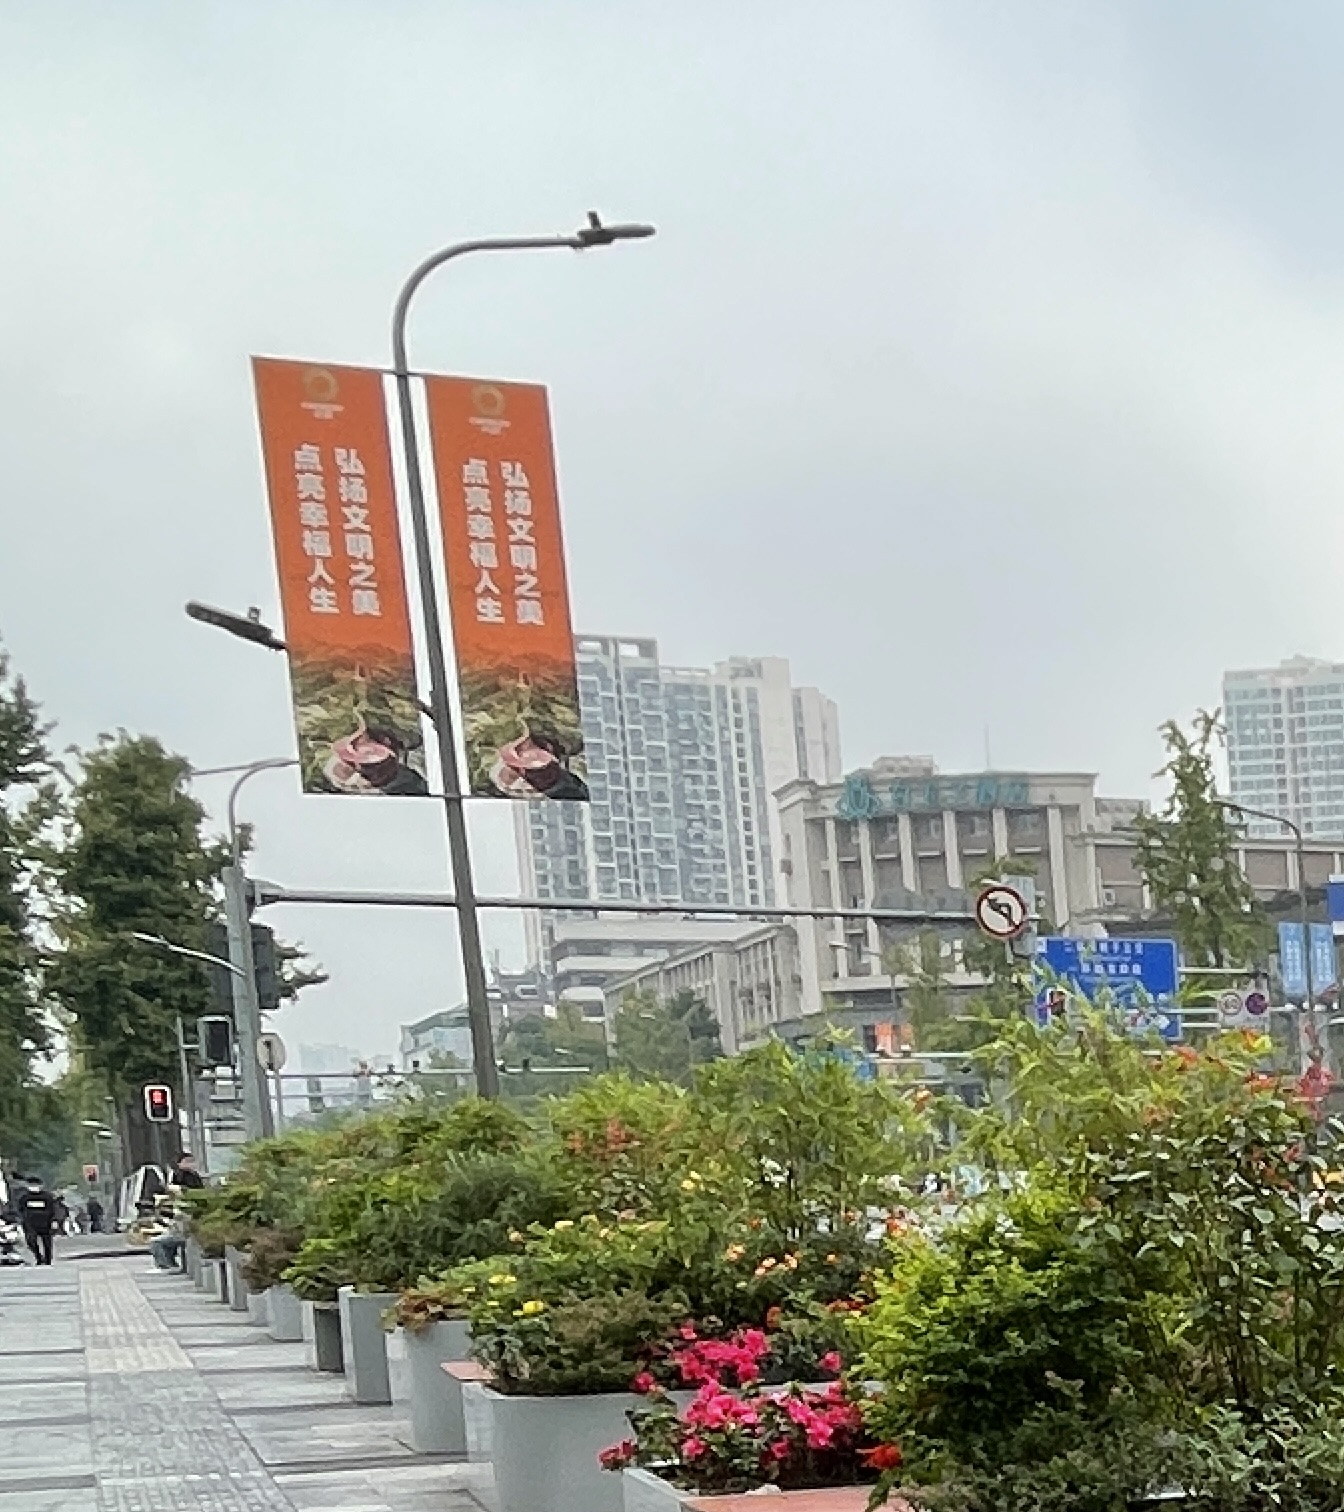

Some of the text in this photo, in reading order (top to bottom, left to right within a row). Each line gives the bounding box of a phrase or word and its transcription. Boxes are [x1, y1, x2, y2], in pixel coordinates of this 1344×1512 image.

[294, 444, 340, 615] 点亮幸福人生
[333, 447, 383, 617] 弘扬文明之美
[462, 459, 505, 624] 点亮幸福人生
[501, 461, 544, 626] 弘扬文明之美
